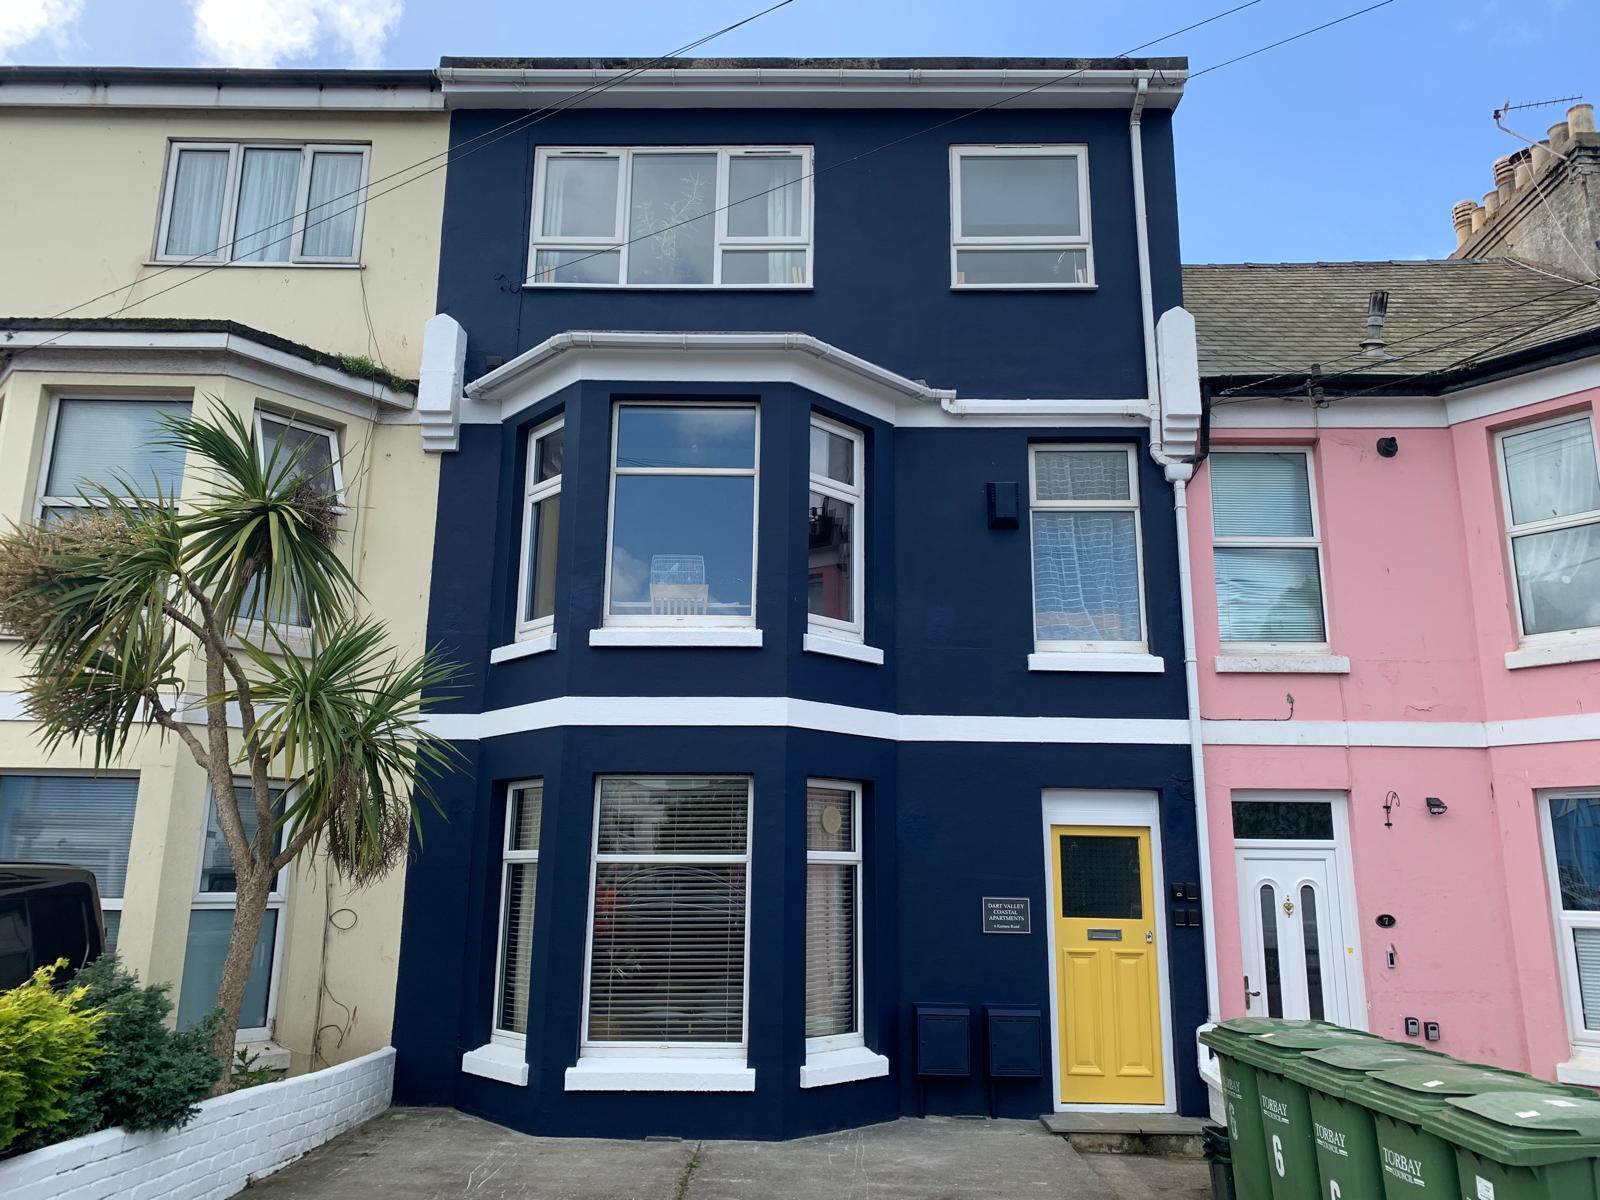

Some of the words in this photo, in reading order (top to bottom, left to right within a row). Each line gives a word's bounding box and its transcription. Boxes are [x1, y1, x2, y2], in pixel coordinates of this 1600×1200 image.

[1261, 1094, 1288, 1117] TORBAY
[1314, 1122, 1346, 1148] TORBAY
[1272, 1134, 1285, 1178] 6
[1382, 1146, 1422, 1177] TORBAY
